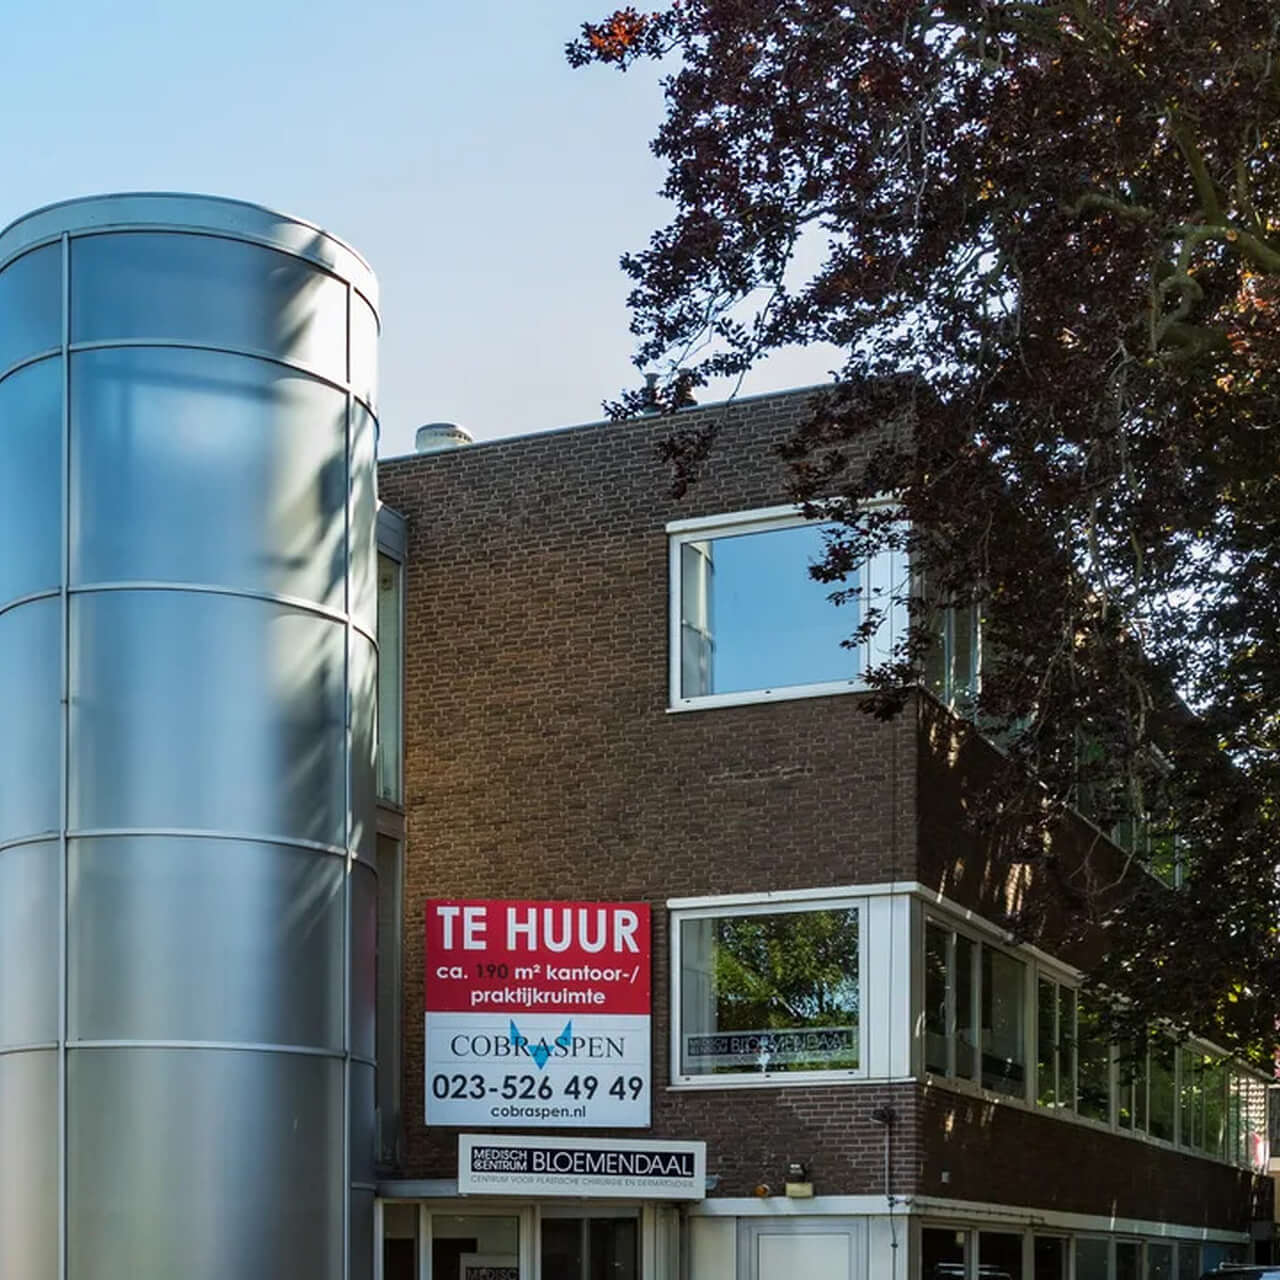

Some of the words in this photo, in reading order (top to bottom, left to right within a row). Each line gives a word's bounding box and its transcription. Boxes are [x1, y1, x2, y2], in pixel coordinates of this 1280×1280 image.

[436, 906, 487, 950] TE
[506, 907, 640, 953] HUUR
[436, 966, 469, 980] ca.
[475, 963, 509, 979] 190
[546, 965, 640, 984] kantoor-/
[470, 988, 606, 1008] praktijkruimte
[450, 1034, 626, 1059] COBRASPEN
[431, 1074, 554, 1101] 023-526
[563, 1075, 599, 1101] 49
[608, 1076, 644, 1101] 49
[490, 1104, 587, 1120] cobraspen.nl
[473, 1148, 528, 1160] MEDISCH
[532, 1151, 692, 1175] BLOEMENDAAL
